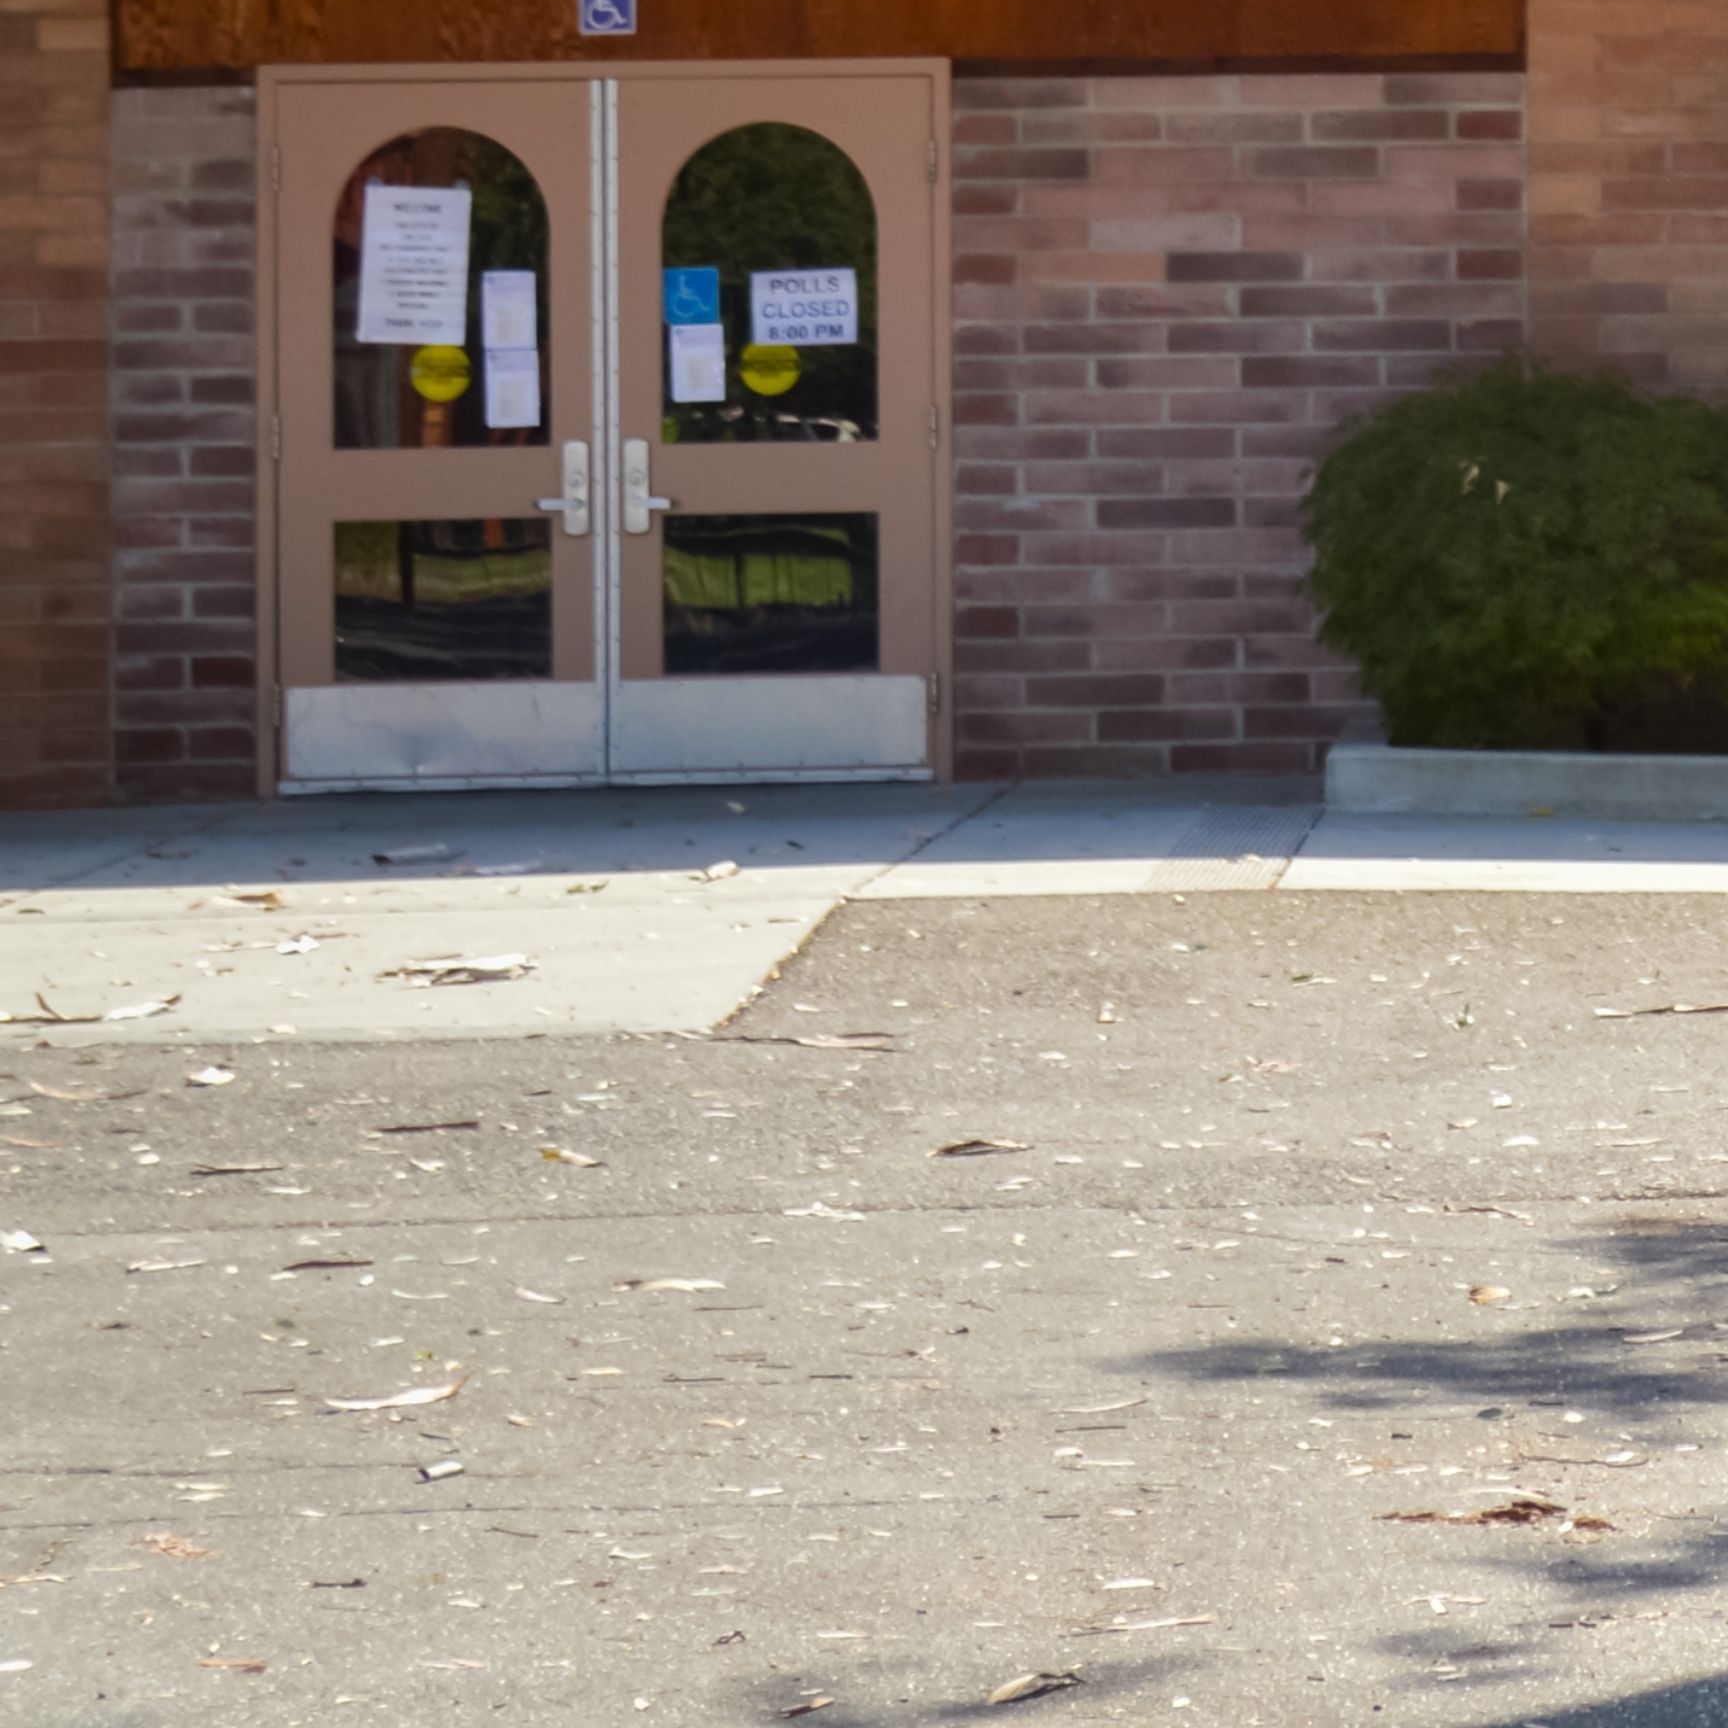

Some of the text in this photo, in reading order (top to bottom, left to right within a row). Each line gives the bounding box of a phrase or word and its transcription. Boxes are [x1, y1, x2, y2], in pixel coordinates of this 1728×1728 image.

[769, 276, 840, 294] POLLS
[762, 299, 850, 319] CLOSED
[768, 323, 844, 340] 8:00 PM
